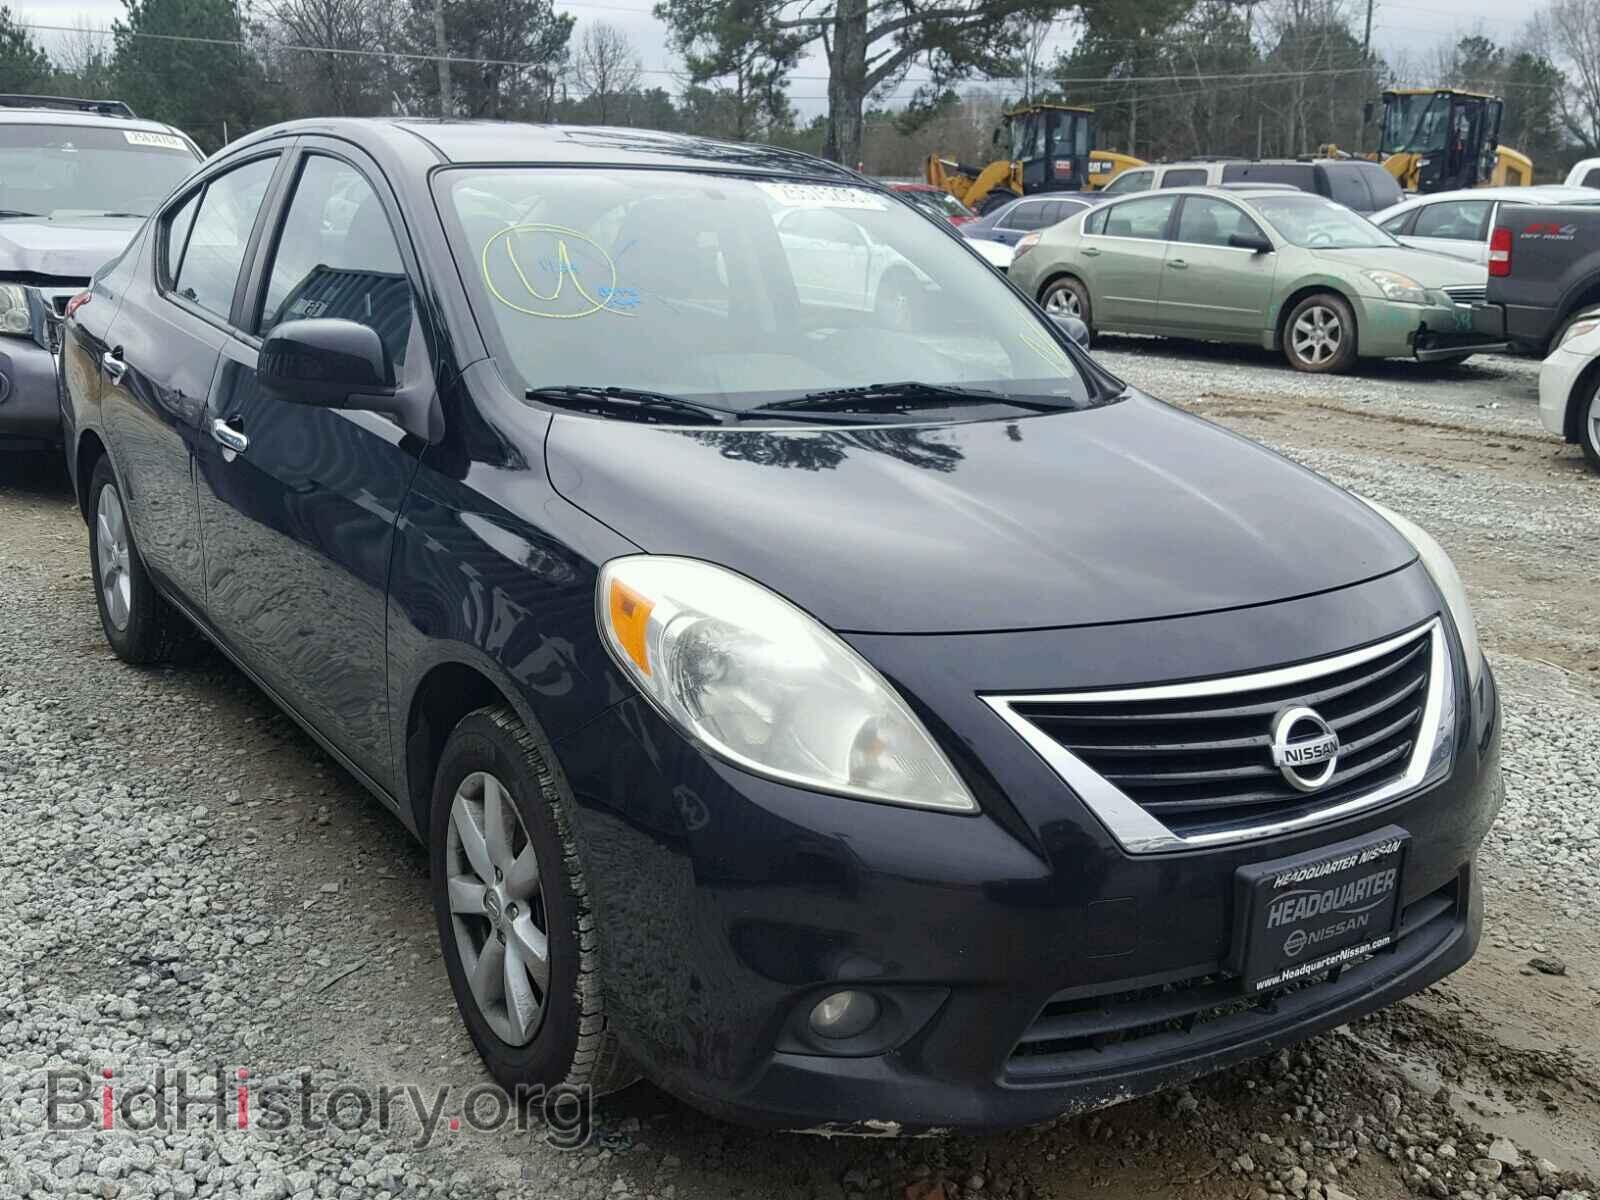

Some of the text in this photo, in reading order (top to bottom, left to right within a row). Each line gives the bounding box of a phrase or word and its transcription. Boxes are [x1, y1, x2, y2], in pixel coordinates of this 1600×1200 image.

[1285, 739, 1338, 763] NISSAN
[1273, 839, 1402, 889] HEADQUARTER NISSAN
[1266, 868, 1396, 929] HEADQUARTER
[1307, 913, 1369, 945] NISSAN
[1256, 936, 1390, 991] www.HeadquarterNissan.com
